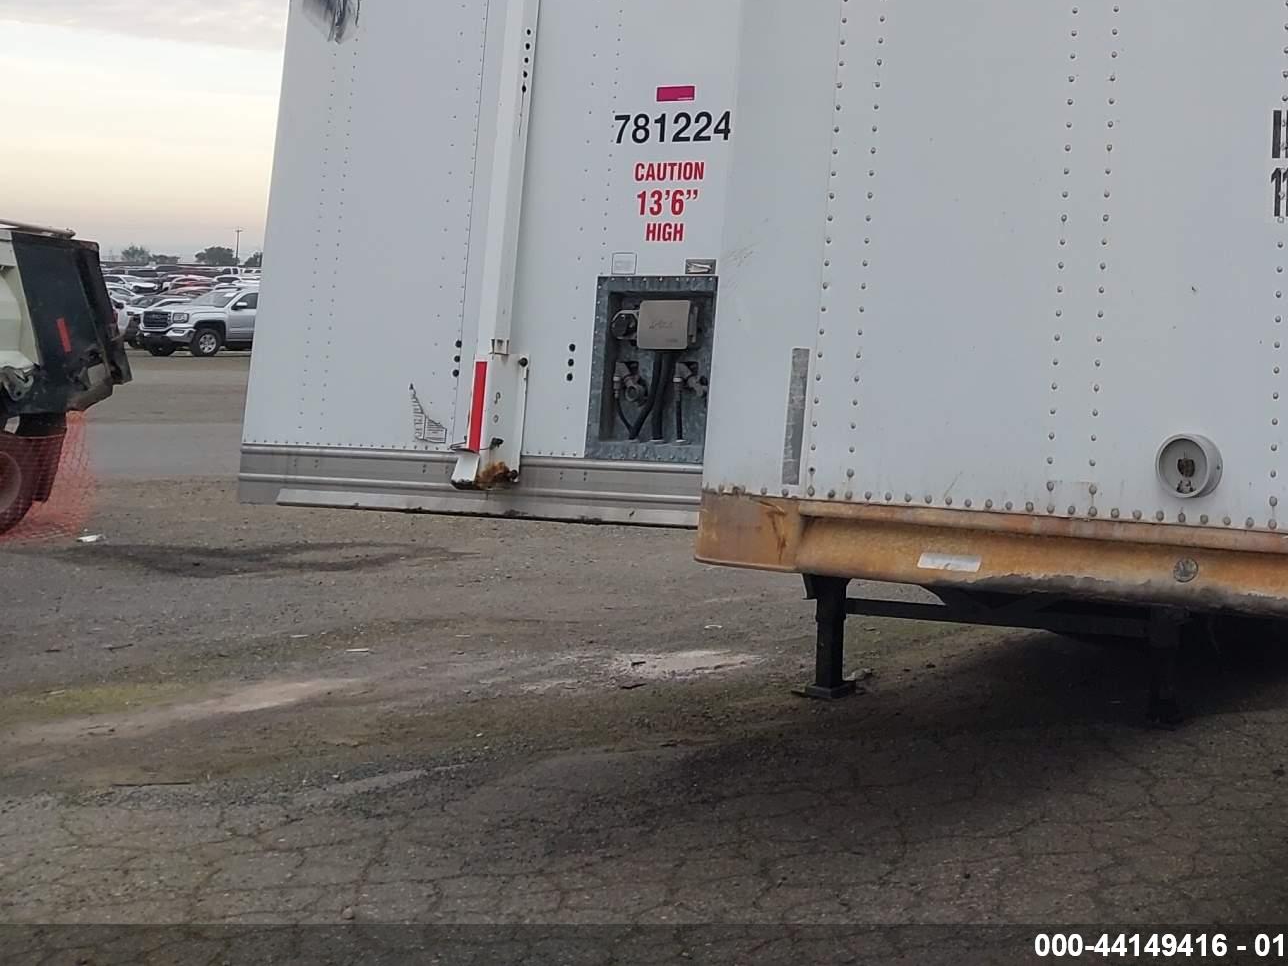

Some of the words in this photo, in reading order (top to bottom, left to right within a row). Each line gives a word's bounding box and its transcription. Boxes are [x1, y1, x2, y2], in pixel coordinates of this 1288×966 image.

[614, 111, 731, 144] 781224
[634, 162, 705, 181] CAUTION
[645, 223, 684, 241] HIGH
